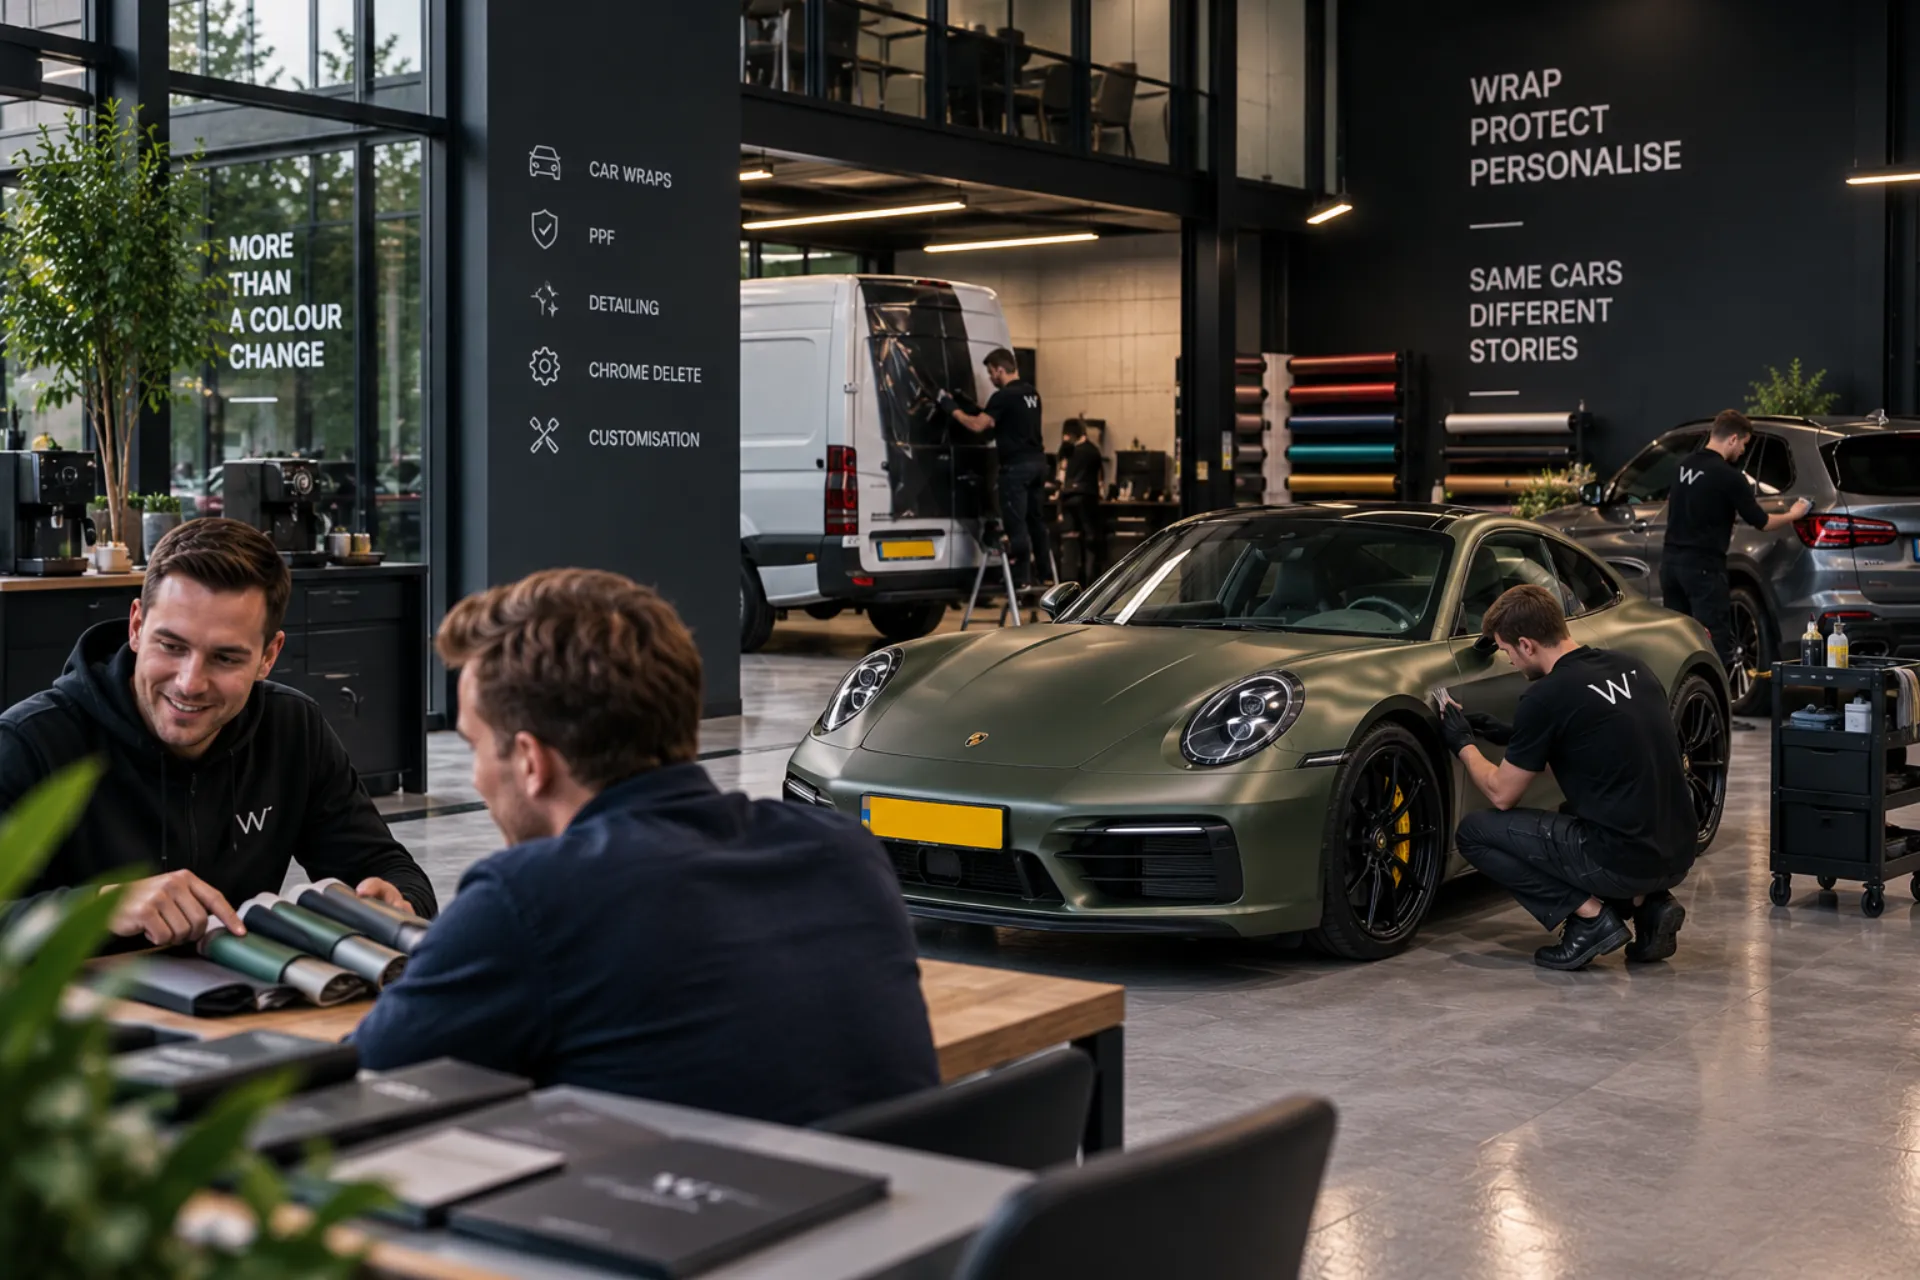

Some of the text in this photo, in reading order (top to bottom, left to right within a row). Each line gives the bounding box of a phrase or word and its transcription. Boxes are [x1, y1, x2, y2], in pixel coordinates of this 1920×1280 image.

[1470, 68, 1562, 105] WRAP
[1470, 104, 1610, 147] PROTECT
[588, 160, 673, 190] CAR WRAPS
[1470, 140, 1683, 188] PERSONALISE
[229, 232, 294, 262] MORE
[588, 227, 615, 247] PPF
[228, 269, 292, 298] THAN
[1469, 259, 1624, 293] SAME CARS
[229, 303, 343, 333] A COLOUR
[588, 294, 660, 317] DETAILING
[1469, 297, 1615, 329] DIFFERENT
[229, 341, 325, 370] CHANGE
[1469, 335, 1580, 364] STORIES
[588, 361, 703, 385] CHROME DELETE
[588, 428, 701, 449] CUSTOMISATION
